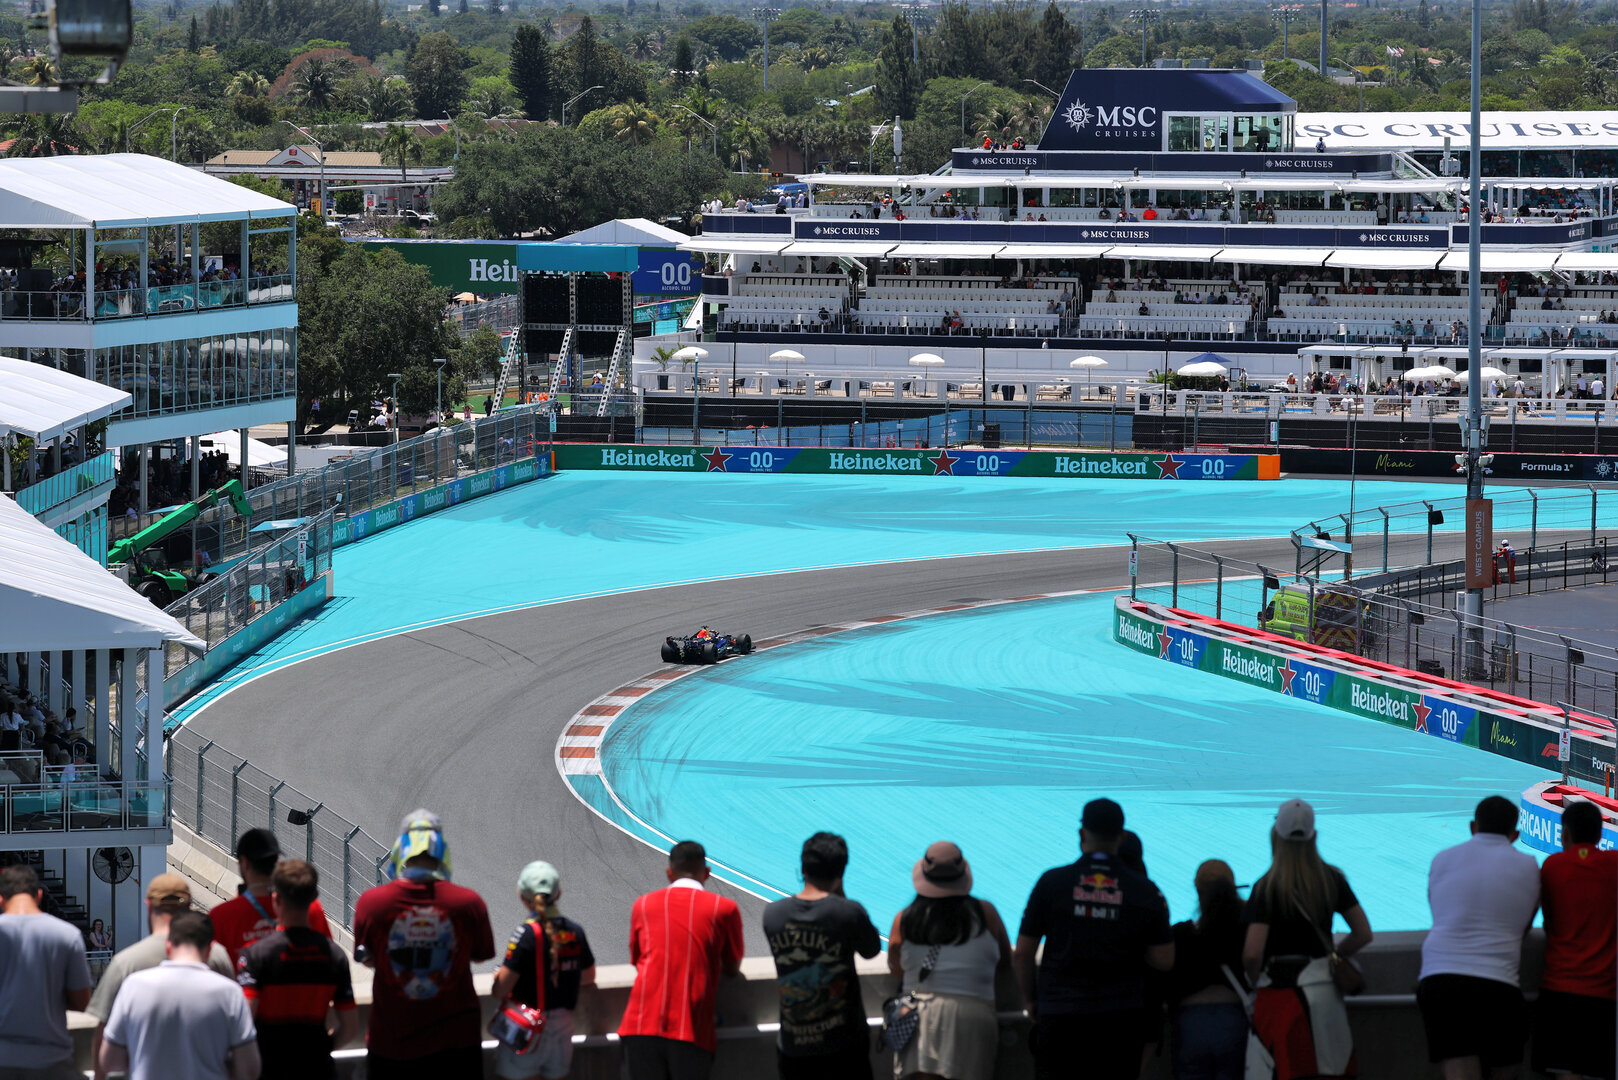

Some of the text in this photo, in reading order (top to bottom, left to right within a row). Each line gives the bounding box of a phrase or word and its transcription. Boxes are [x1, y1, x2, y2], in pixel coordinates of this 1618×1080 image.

[1095, 105, 1156, 128] MSC
[1095, 130, 1156, 138] CRUISES
[1296, 125, 1369, 138] SC
[979, 157, 1037, 166] MSC CRUISES
[1274, 159, 1333, 169] MSC CRUISES
[822, 227, 880, 236] MSC CRUISES
[1090, 230, 1150, 239] MSC CRUISES
[1369, 233, 1430, 243] MSC CRUISES
[661, 262, 691, 285] 0.0
[601, 448, 773, 468] Heineken 0.0
[829, 452, 999, 471] Heineken 0.0
[1054, 456, 1224, 475] Heineken 0.0
[1375, 453, 1416, 472] Miami
[1520, 462, 1562, 472] Formula
[1119, 614, 1154, 650] Heineken
[1223, 647, 1320, 696] Heineken 0.0
[1351, 682, 1457, 735] Heineken 0.0
[770, 930, 842, 956] SUZUKA
